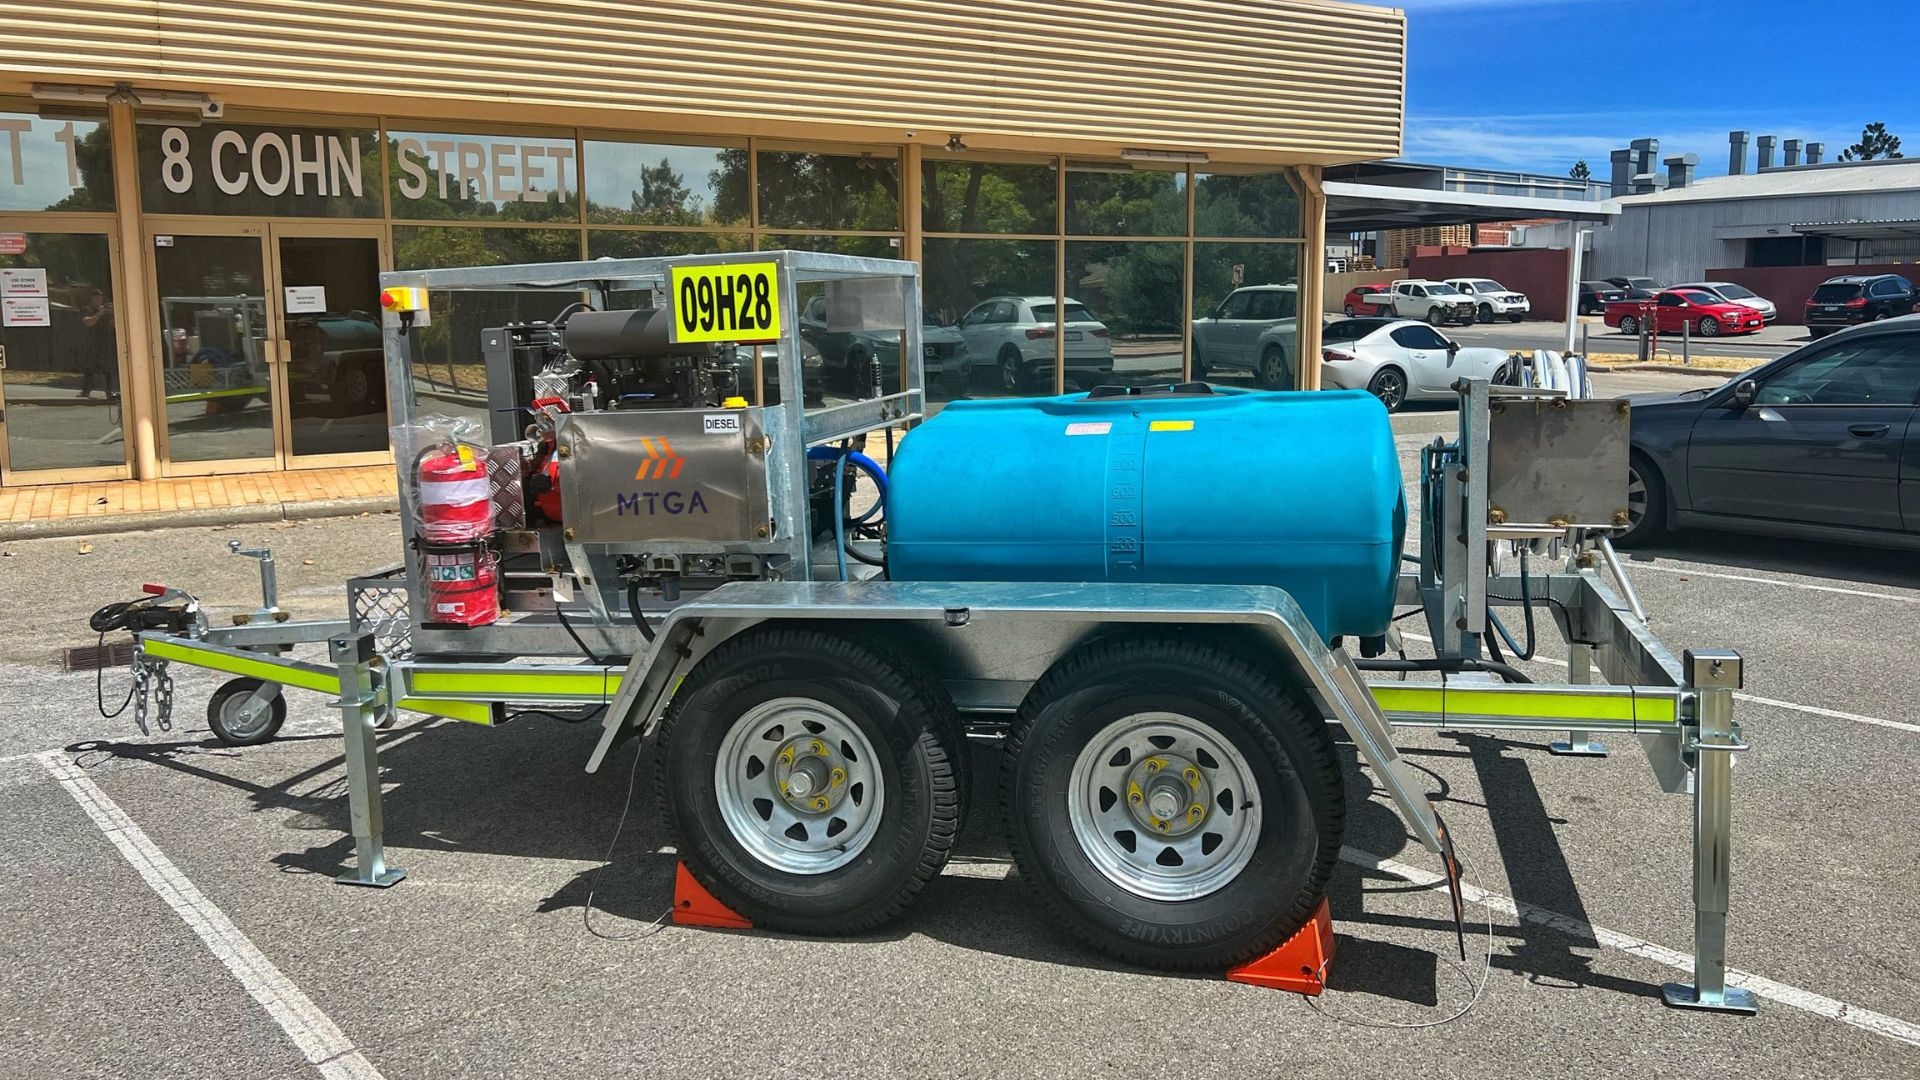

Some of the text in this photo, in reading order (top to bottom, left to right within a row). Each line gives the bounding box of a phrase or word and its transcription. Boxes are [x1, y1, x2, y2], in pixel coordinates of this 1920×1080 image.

[161, 127, 193, 194] 8
[211, 130, 363, 198] COHN
[397, 138, 574, 203] STREET
[680, 273, 772, 333] 09H28
[705, 419, 738, 429] DIESEL
[617, 490, 709, 516] MTGA
[1111, 487, 1136, 497] 600
[1111, 513, 1136, 524] 500
[1117, 902, 1257, 944] COUNTRYLIFE
